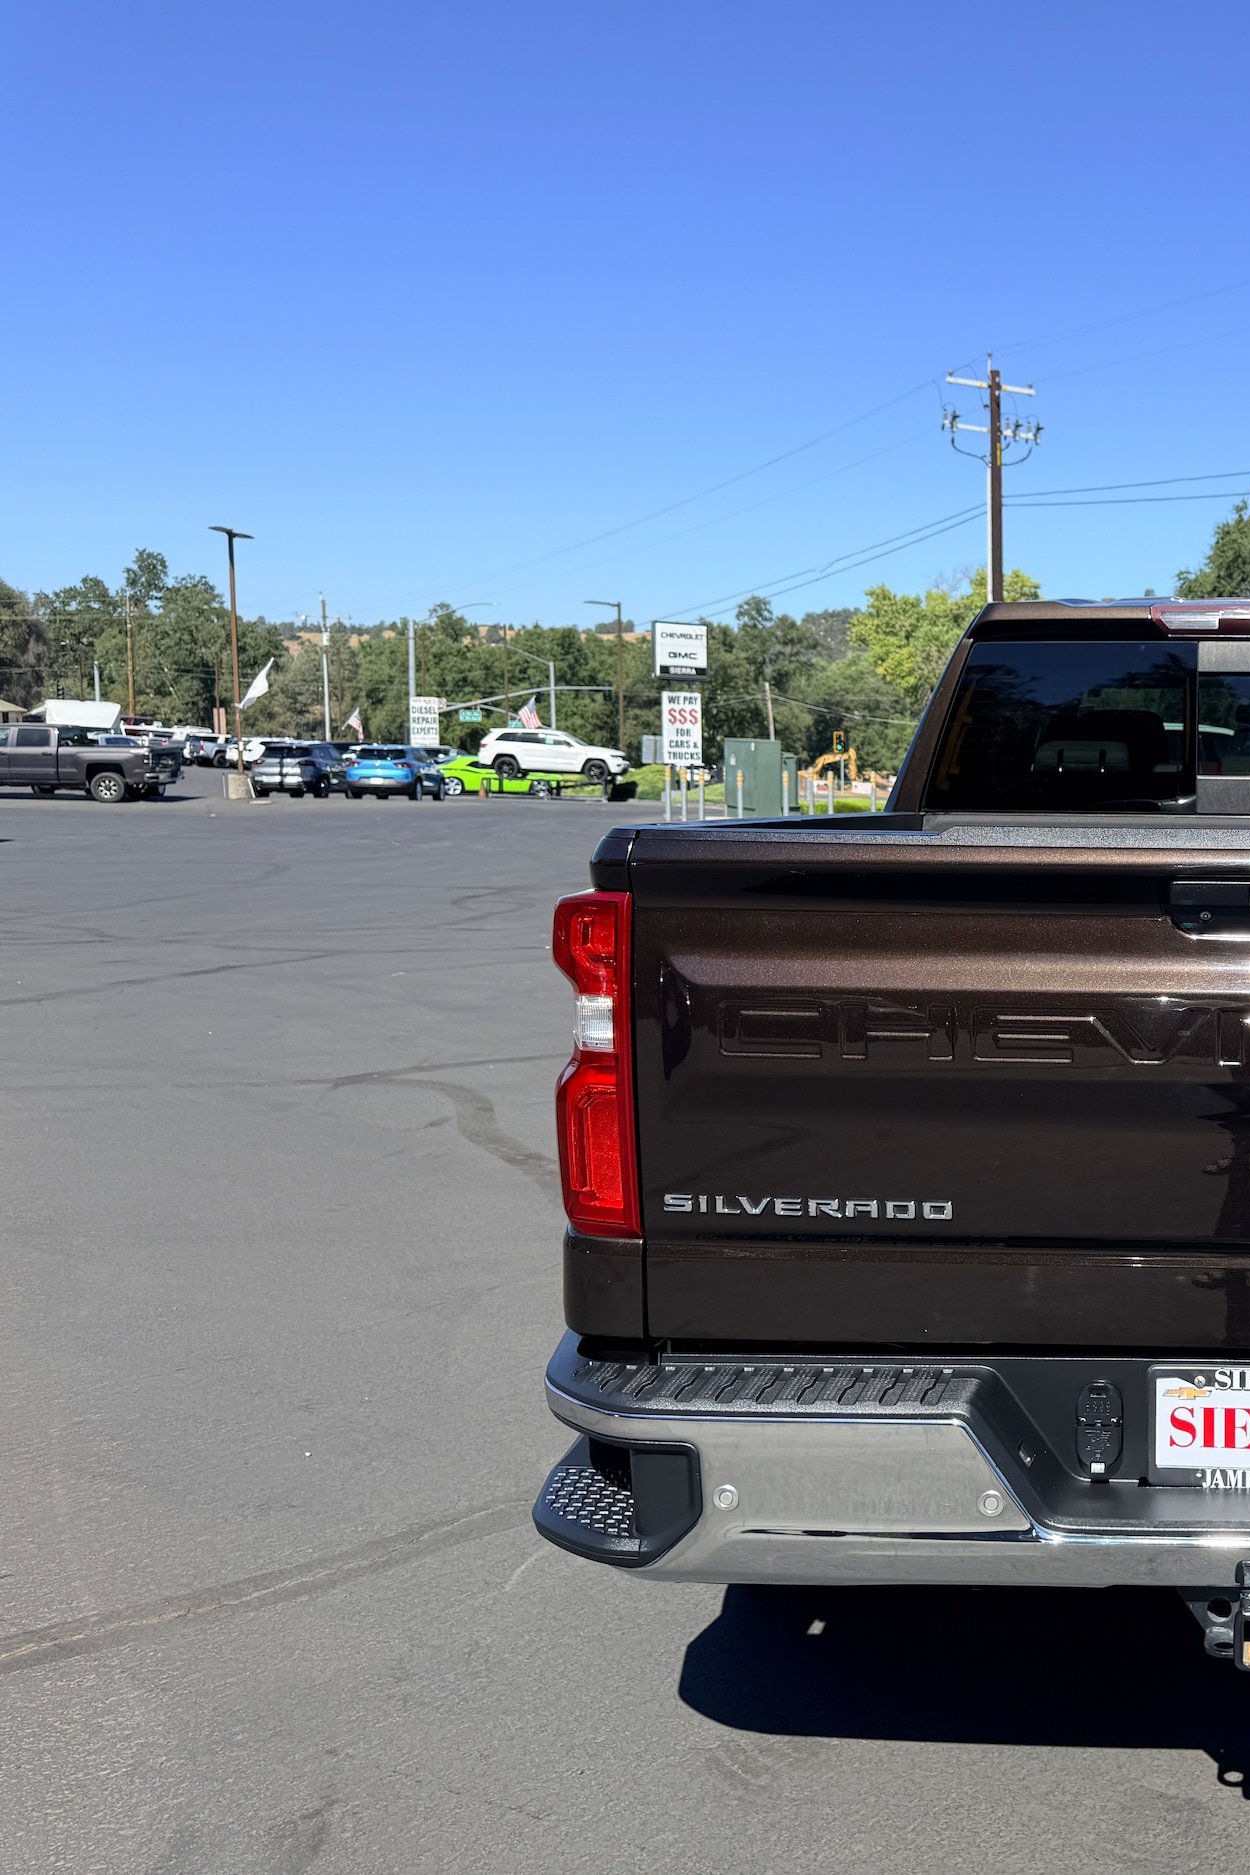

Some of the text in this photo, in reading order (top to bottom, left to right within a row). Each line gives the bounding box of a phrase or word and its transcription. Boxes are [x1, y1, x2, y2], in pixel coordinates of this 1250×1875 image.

[660, 631, 704, 641] CHEVROLET
[668, 651, 698, 660] GMC
[669, 666, 697, 675] SIERRA
[667, 695, 698, 705] WE PAY
[411, 706, 438, 715] DIESEL
[411, 716, 438, 725] REPAIR
[667, 707, 699, 725] $$$
[412, 726, 439, 736] EXPERTS
[676, 728, 692, 737] FOR
[669, 739, 691, 749] CARS
[667, 751, 701, 760] TRUCKS
[663, 1193, 954, 1220] SILVERADO
